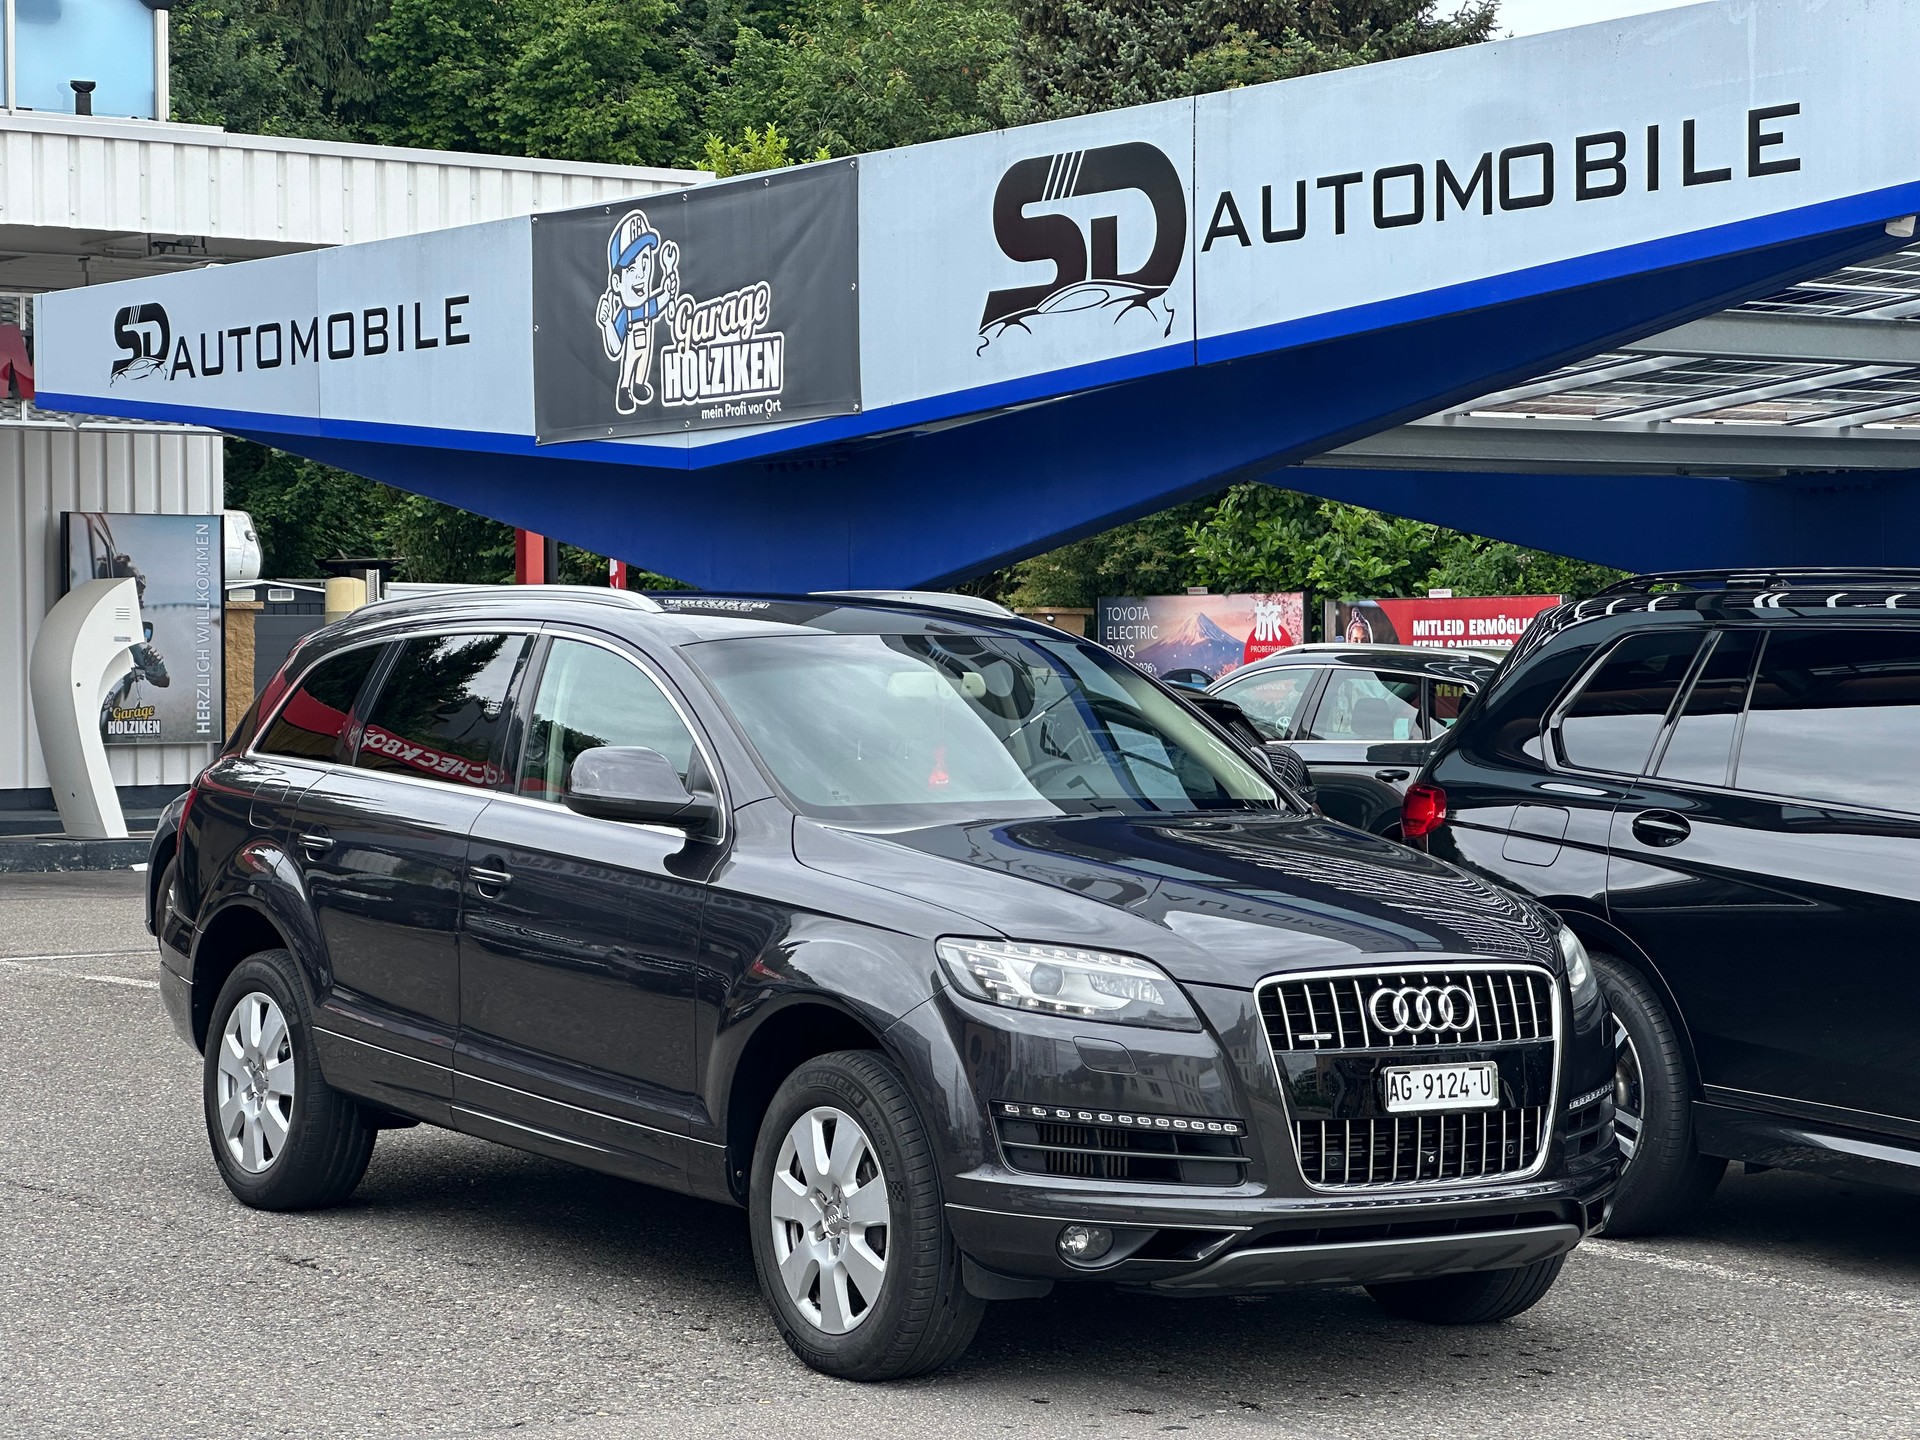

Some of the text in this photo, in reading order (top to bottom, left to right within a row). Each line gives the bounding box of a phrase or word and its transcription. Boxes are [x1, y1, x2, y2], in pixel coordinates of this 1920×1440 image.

[978, 102, 1801, 345] SD AUTOMOBILE
[675, 287, 769, 356] Garage
[111, 302, 170, 379] SD
[170, 295, 470, 381] AUTOMOBILE
[664, 339, 781, 400] HOLZIKEN
[701, 398, 782, 420] mein Profi vor Ort
[1106, 606, 1150, 621] TOYOTA
[195, 523, 211, 734] HERZLICH WILLKOMMEN
[1106, 625, 1159, 640] ELECTRIC
[1412, 619, 1465, 636] MITLEID
[112, 706, 155, 720] Garage
[107, 720, 161, 735] HOLZIKEN
